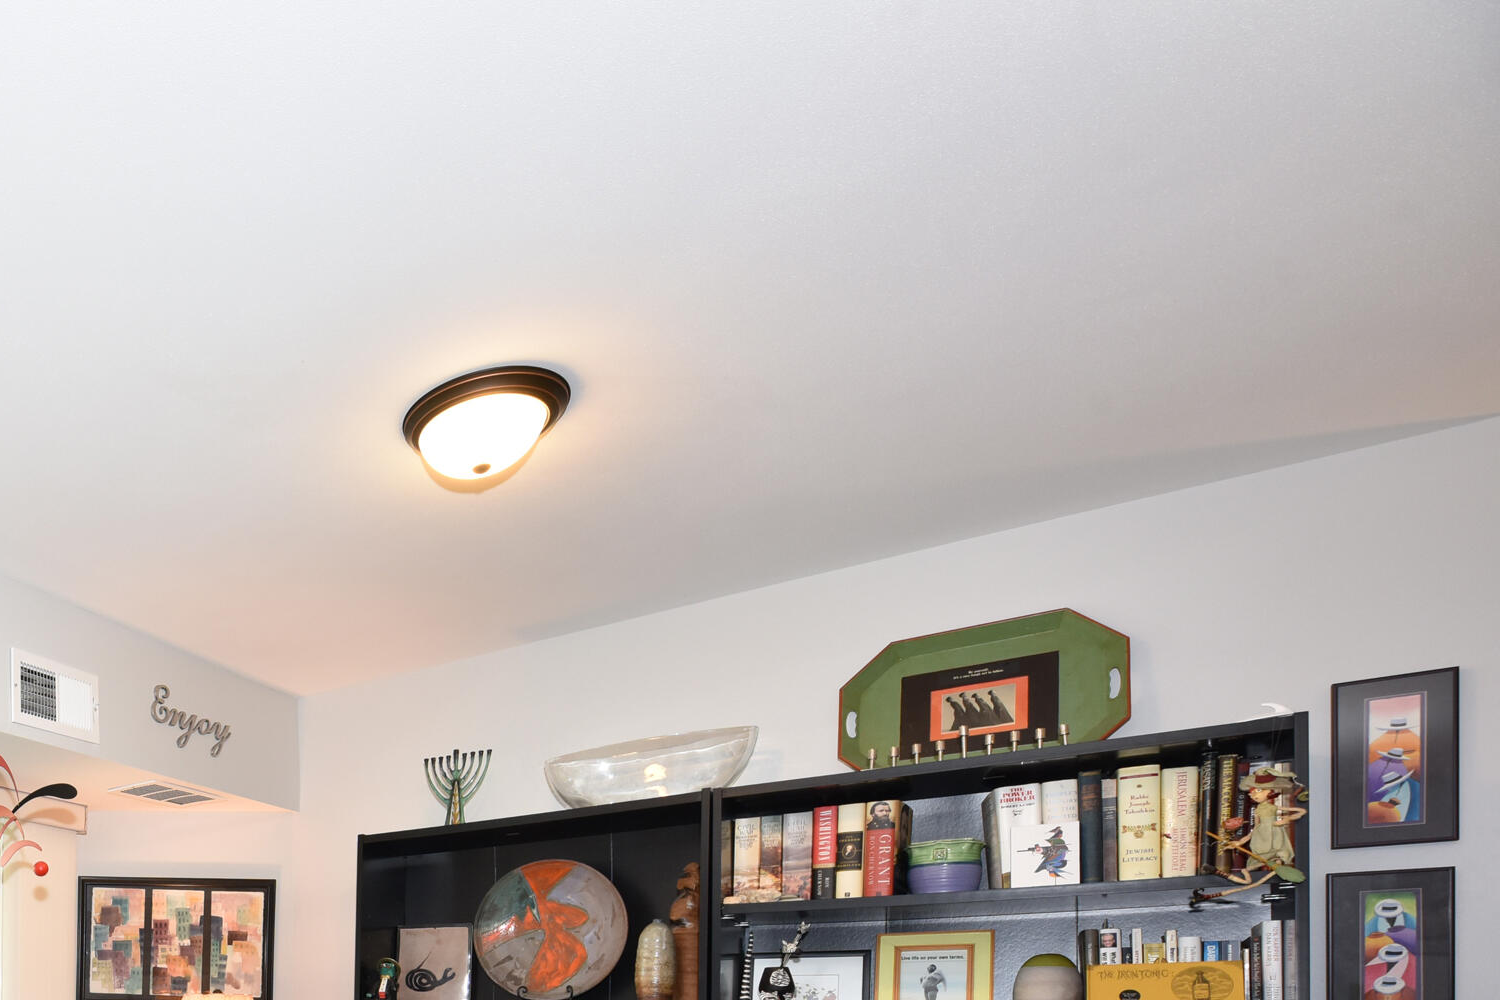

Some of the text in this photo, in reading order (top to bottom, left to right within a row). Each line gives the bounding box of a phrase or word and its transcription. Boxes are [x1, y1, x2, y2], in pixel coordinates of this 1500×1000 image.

[150, 684, 231, 758] Enjoy
[1223, 758, 1233, 777] THE
[1177, 771, 1188, 817] JERUSALEM
[818, 809, 833, 861] WASHINGTON
[878, 834, 892, 885] GRANT
